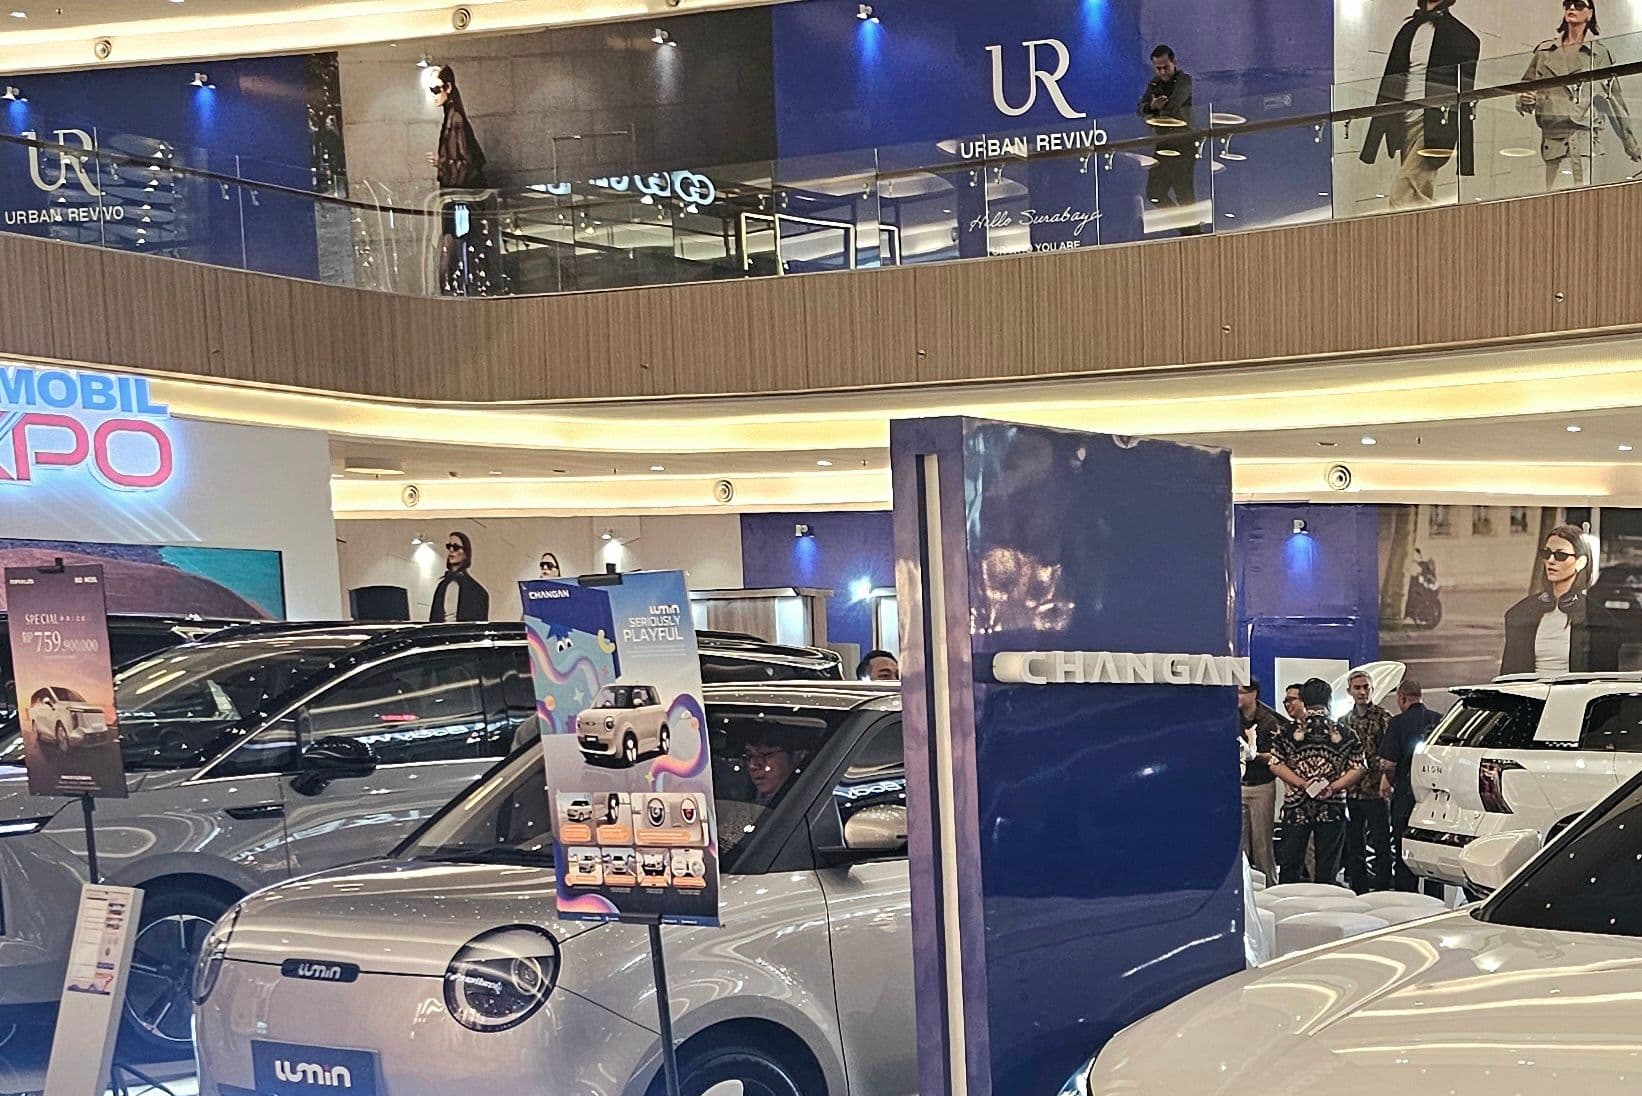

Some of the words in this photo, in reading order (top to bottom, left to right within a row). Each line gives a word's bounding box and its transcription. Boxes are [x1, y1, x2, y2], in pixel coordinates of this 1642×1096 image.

[986, 38, 1086, 119] UR
[960, 136, 1028, 158] URBAN
[1036, 129, 1108, 152] REVIVO
[4, 208, 63, 225] URBAN
[68, 205, 125, 222] REVIVO
[0, 367, 169, 415] MOBIL
[528, 589, 570, 600] CHANGAN
[24, 613, 59, 625] SPECIAL
[629, 615, 681, 628] SERIOUSLY
[623, 627, 684, 642] PLAYFUL
[1021, 650, 1250, 686] CHANGAN
